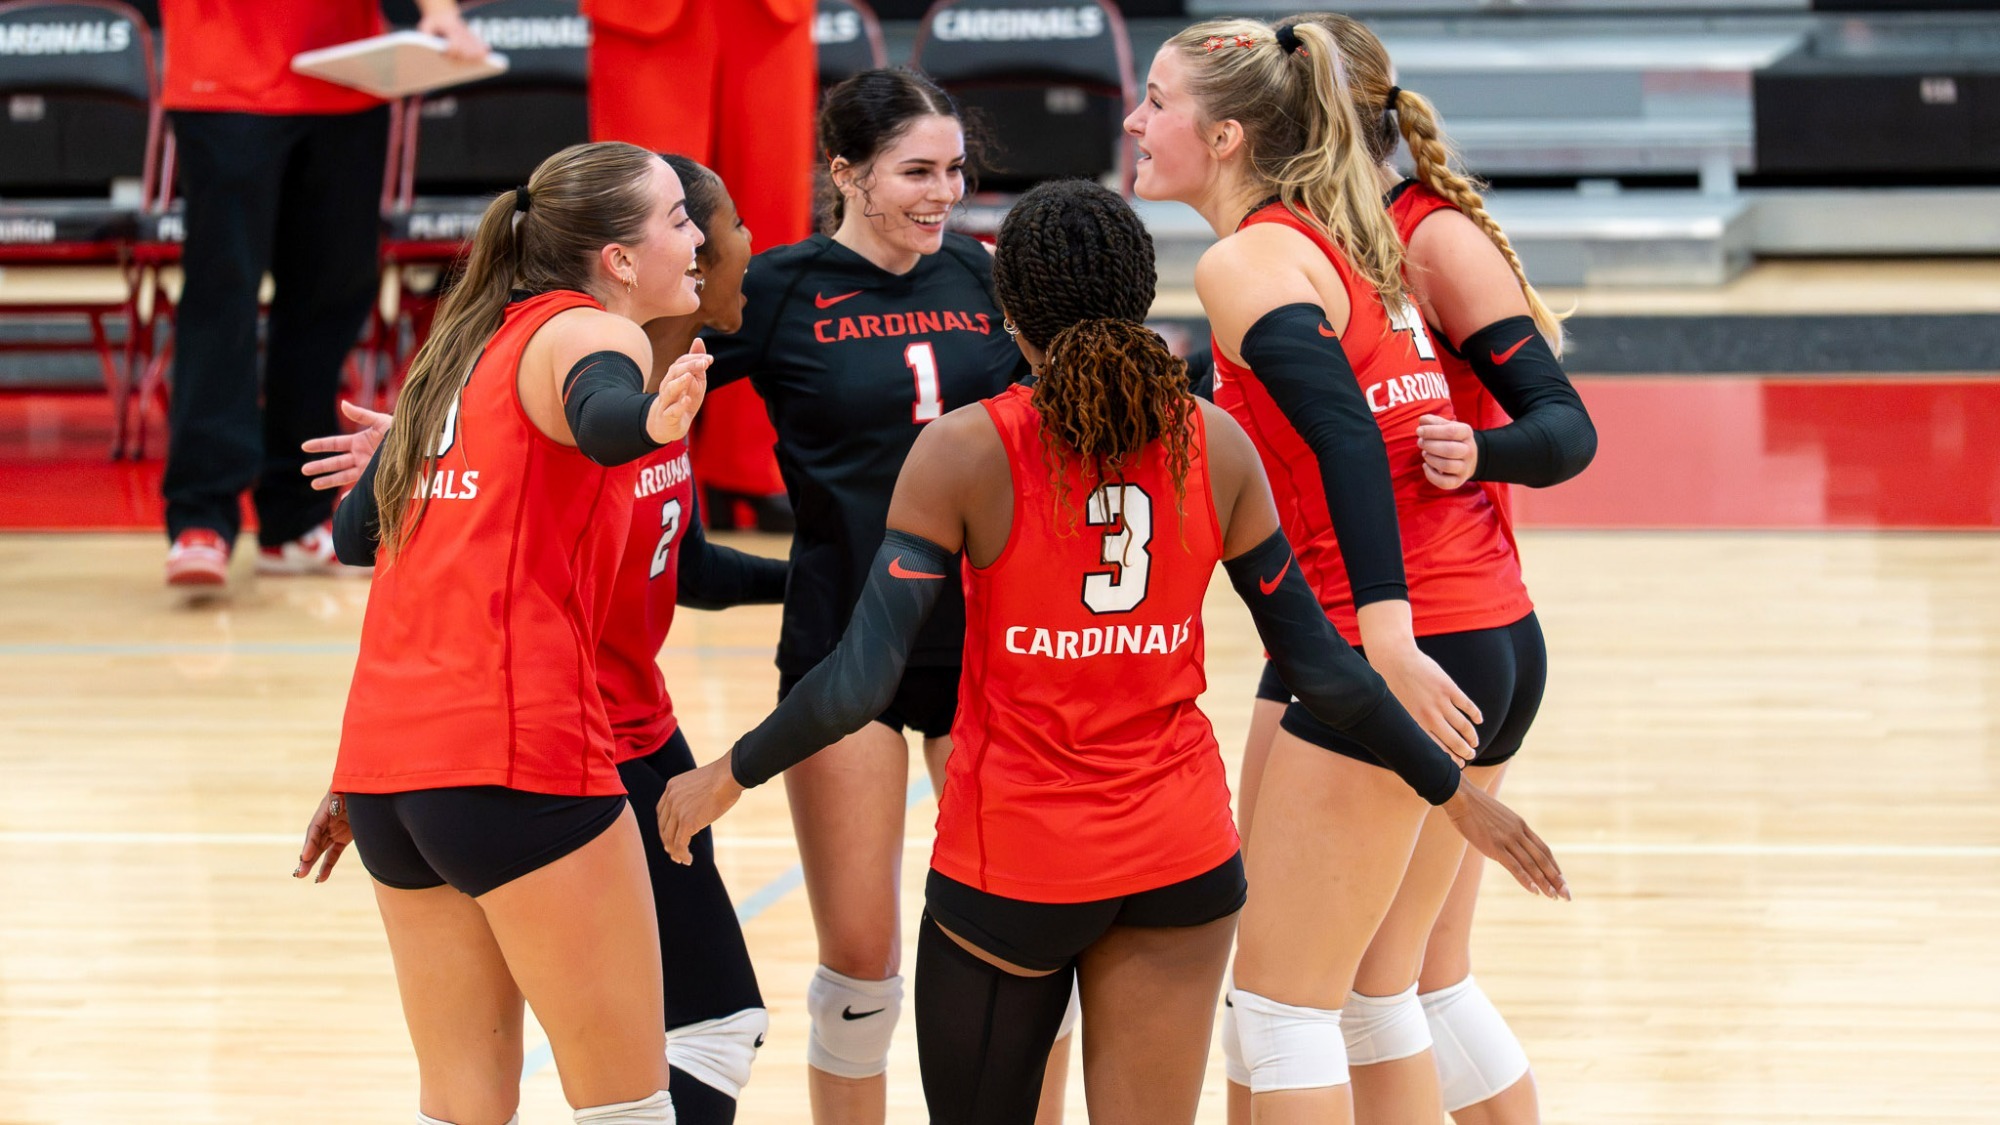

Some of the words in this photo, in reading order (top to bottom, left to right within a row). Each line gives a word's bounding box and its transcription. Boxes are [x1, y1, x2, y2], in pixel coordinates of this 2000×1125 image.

[0, 20, 130, 54] ARDINALS
[468, 16, 590, 48] ARDINAL
[933, 6, 1102, 41] CARDINALS
[813, 311, 991, 343] CARDINALS
[904, 341, 944, 424] 1
[649, 496, 682, 581] 2
[1081, 482, 1153, 616] 3
[1005, 615, 1193, 660] CARDINALS
